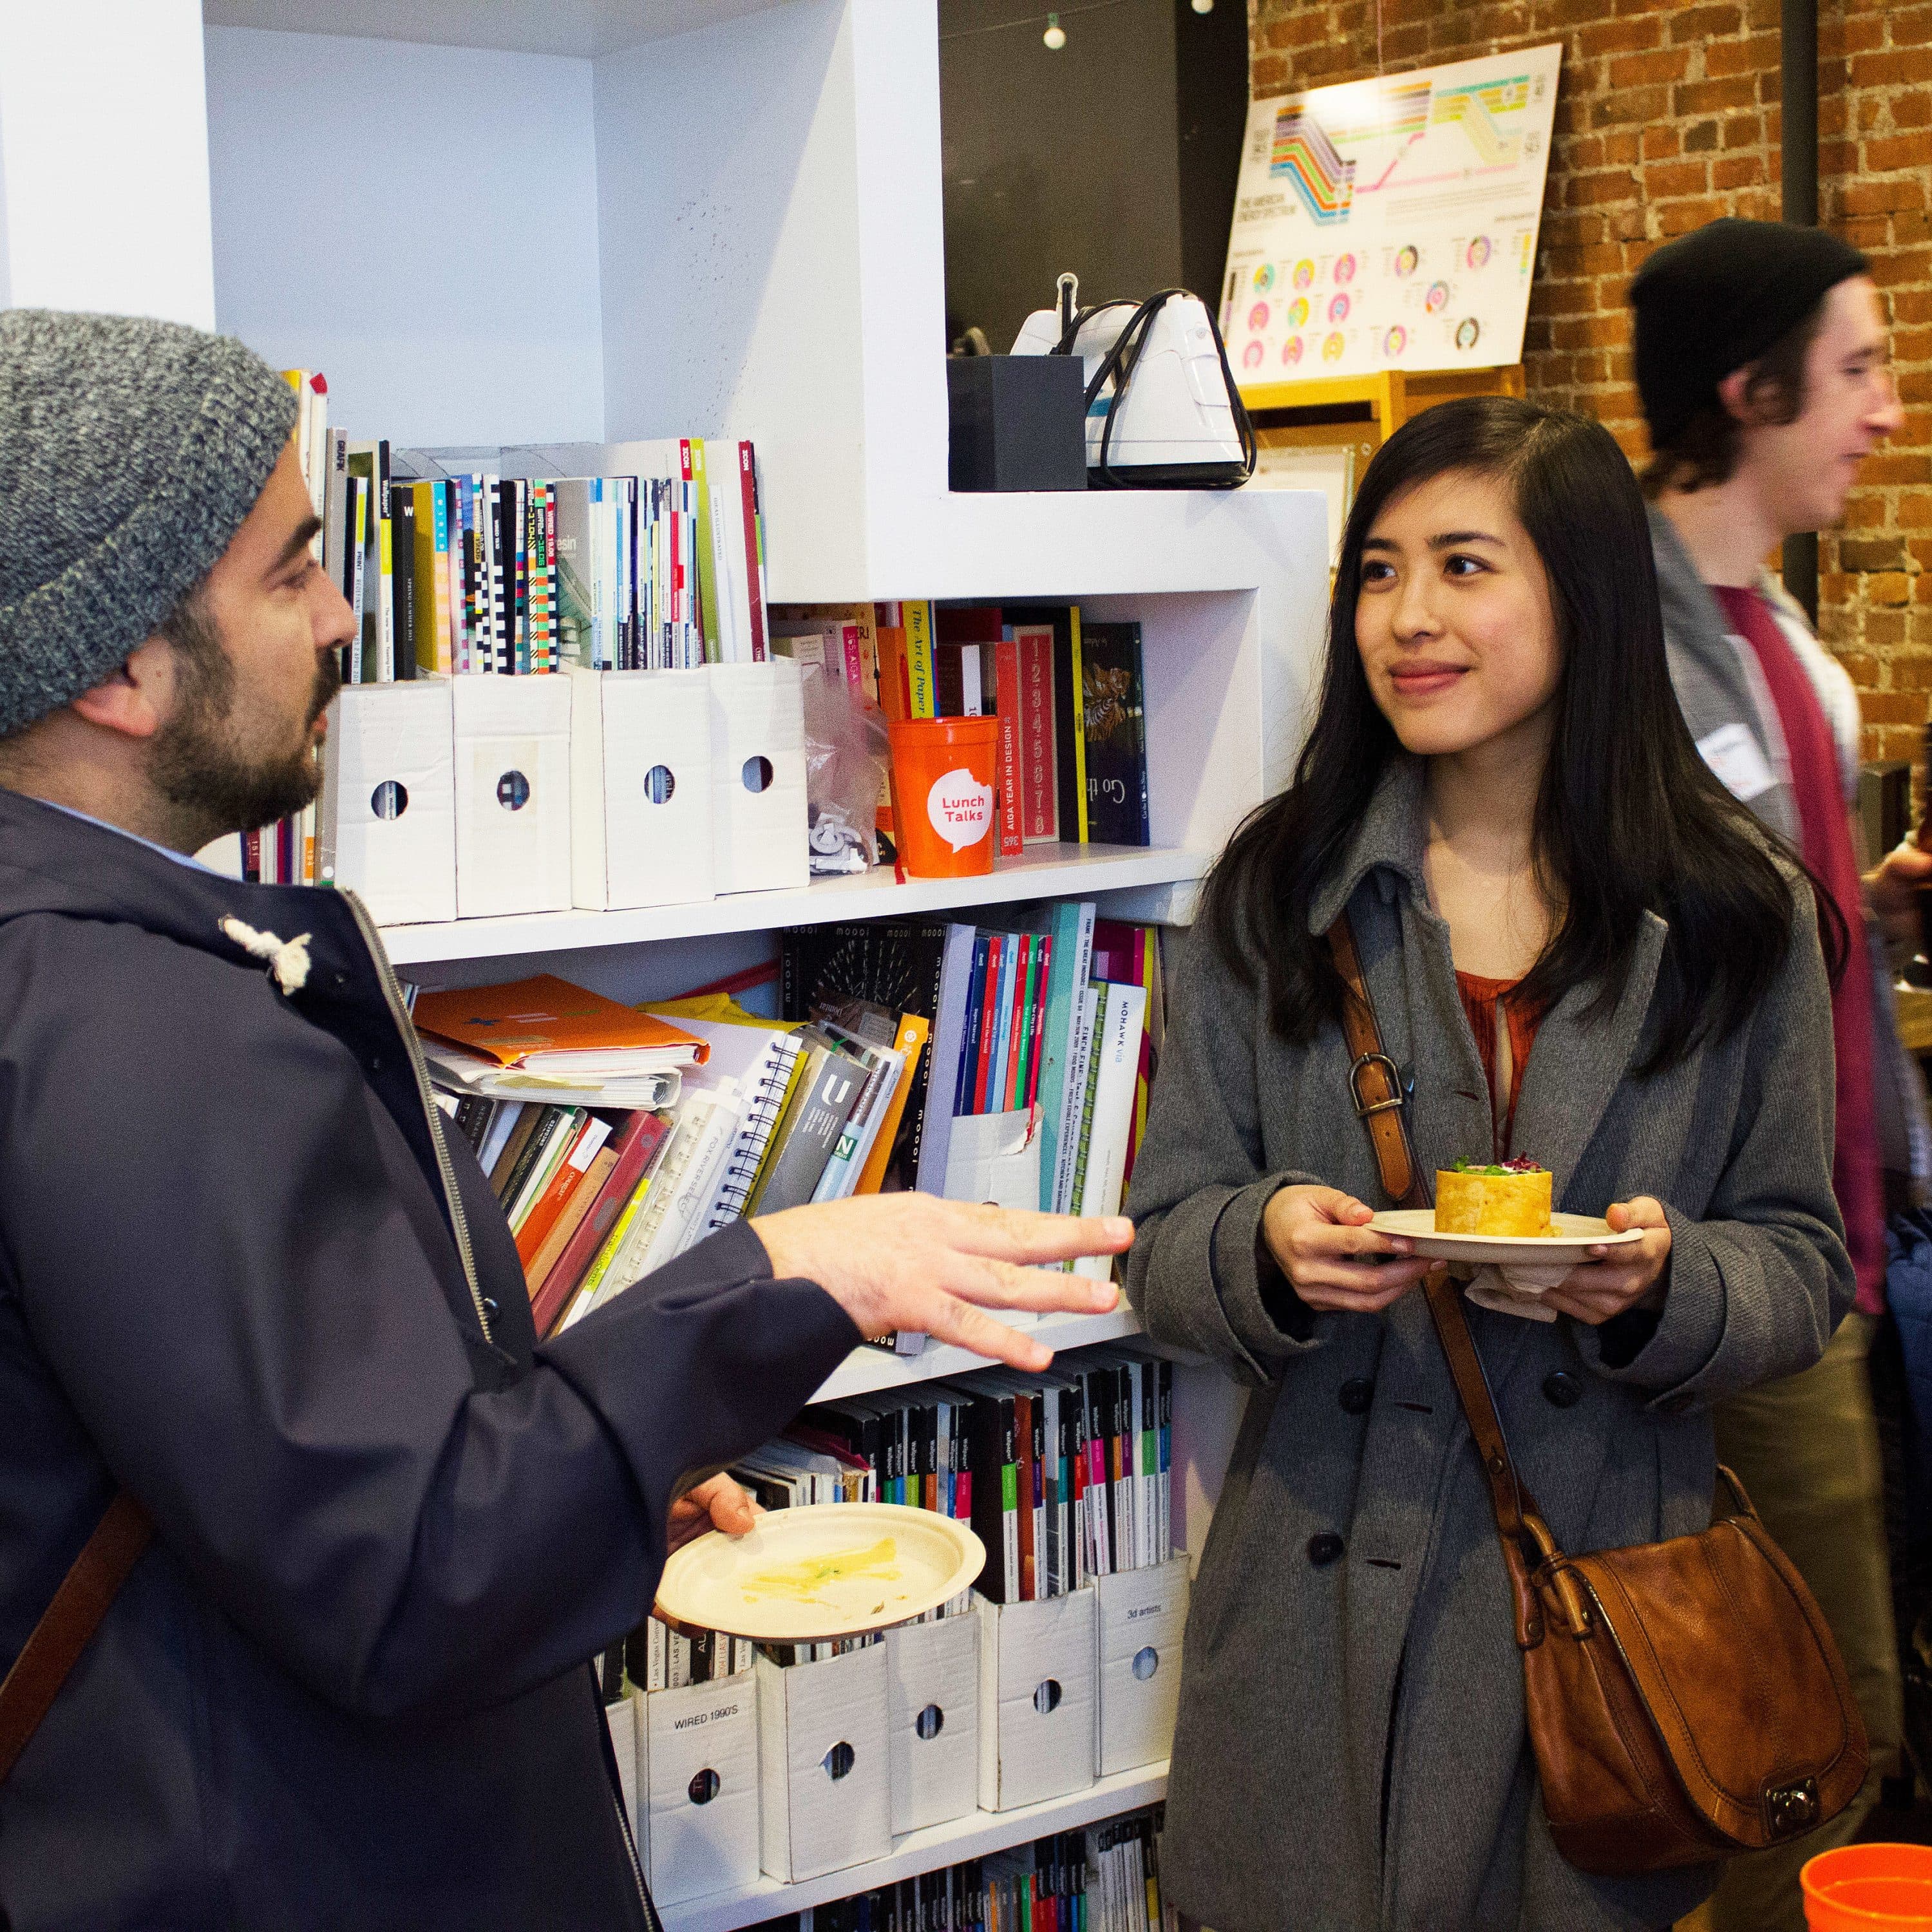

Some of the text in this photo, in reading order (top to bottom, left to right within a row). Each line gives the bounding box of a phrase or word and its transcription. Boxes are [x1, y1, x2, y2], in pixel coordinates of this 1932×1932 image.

[741, 450, 750, 471] ICON
[404, 506, 413, 516] W
[913, 609, 926, 713] The Art of Paper
[1004, 726, 1015, 830] AIGA YEAR IN DESIGN
[942, 795, 985, 809] Lunch
[1103, 779, 1126, 804] Go
[944, 810, 983, 822] Talks
[1117, 1001, 1128, 1046] MOHAWK
[835, 1135, 854, 1155] N
[692, 1155, 711, 1182] RIVER
[866, 1336, 895, 1347] moo
[1127, 1609, 1138, 1619] 3d
[652, 1646, 661, 1667] Vegas
[674, 1705, 739, 1730] WIRED 1990'S
